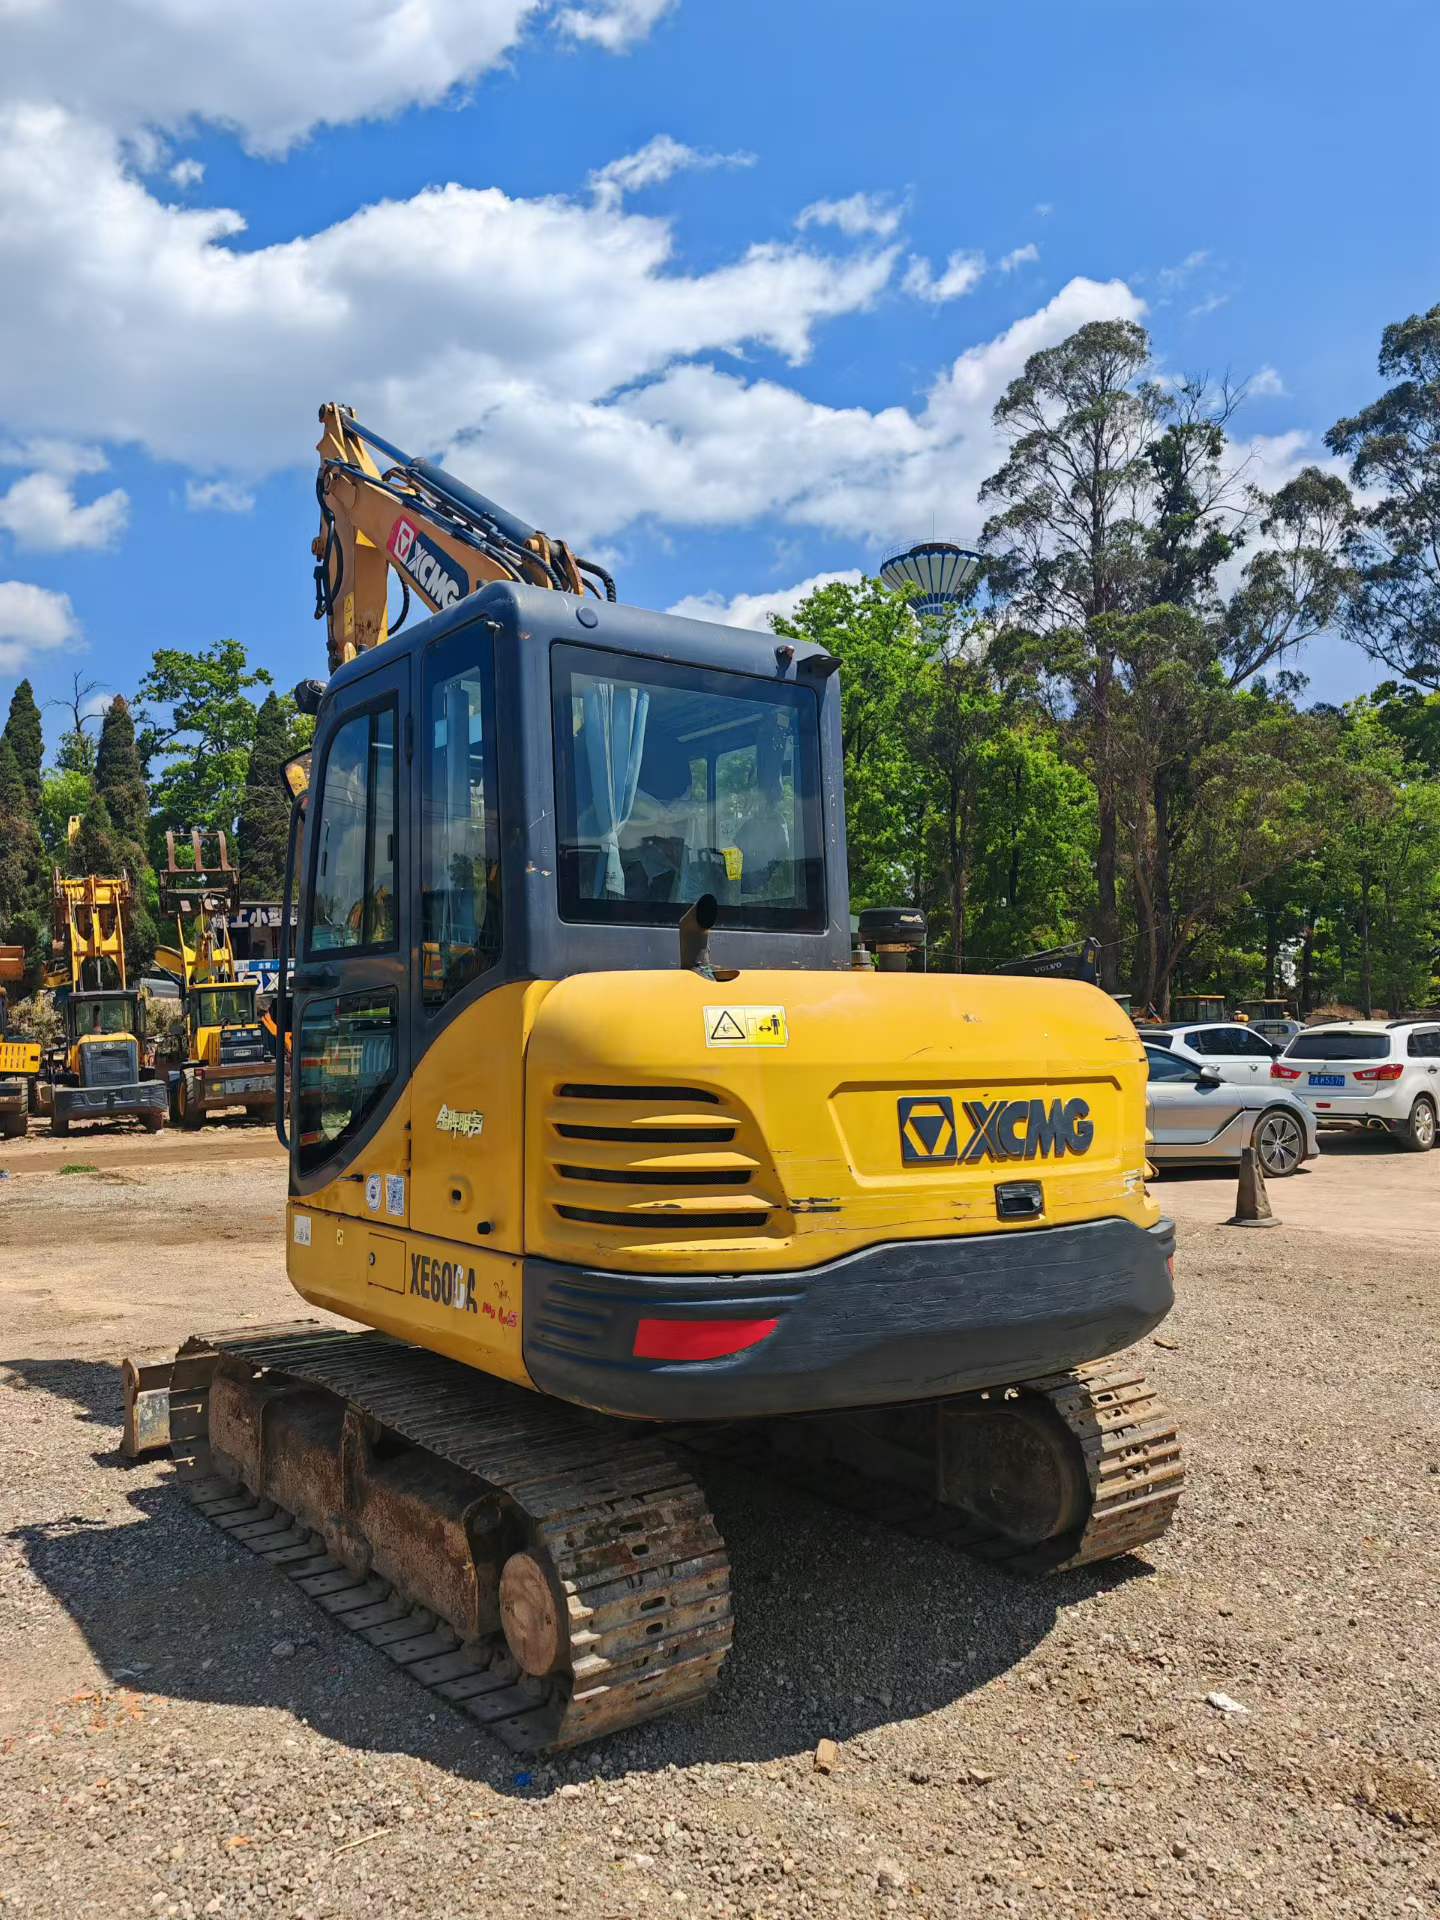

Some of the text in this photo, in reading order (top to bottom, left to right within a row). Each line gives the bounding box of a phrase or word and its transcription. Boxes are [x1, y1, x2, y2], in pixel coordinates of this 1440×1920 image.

[405, 541, 460, 609] XCMG
[1034, 961, 1062, 973] VOLVO
[957, 1097, 1094, 1165] XCMG
